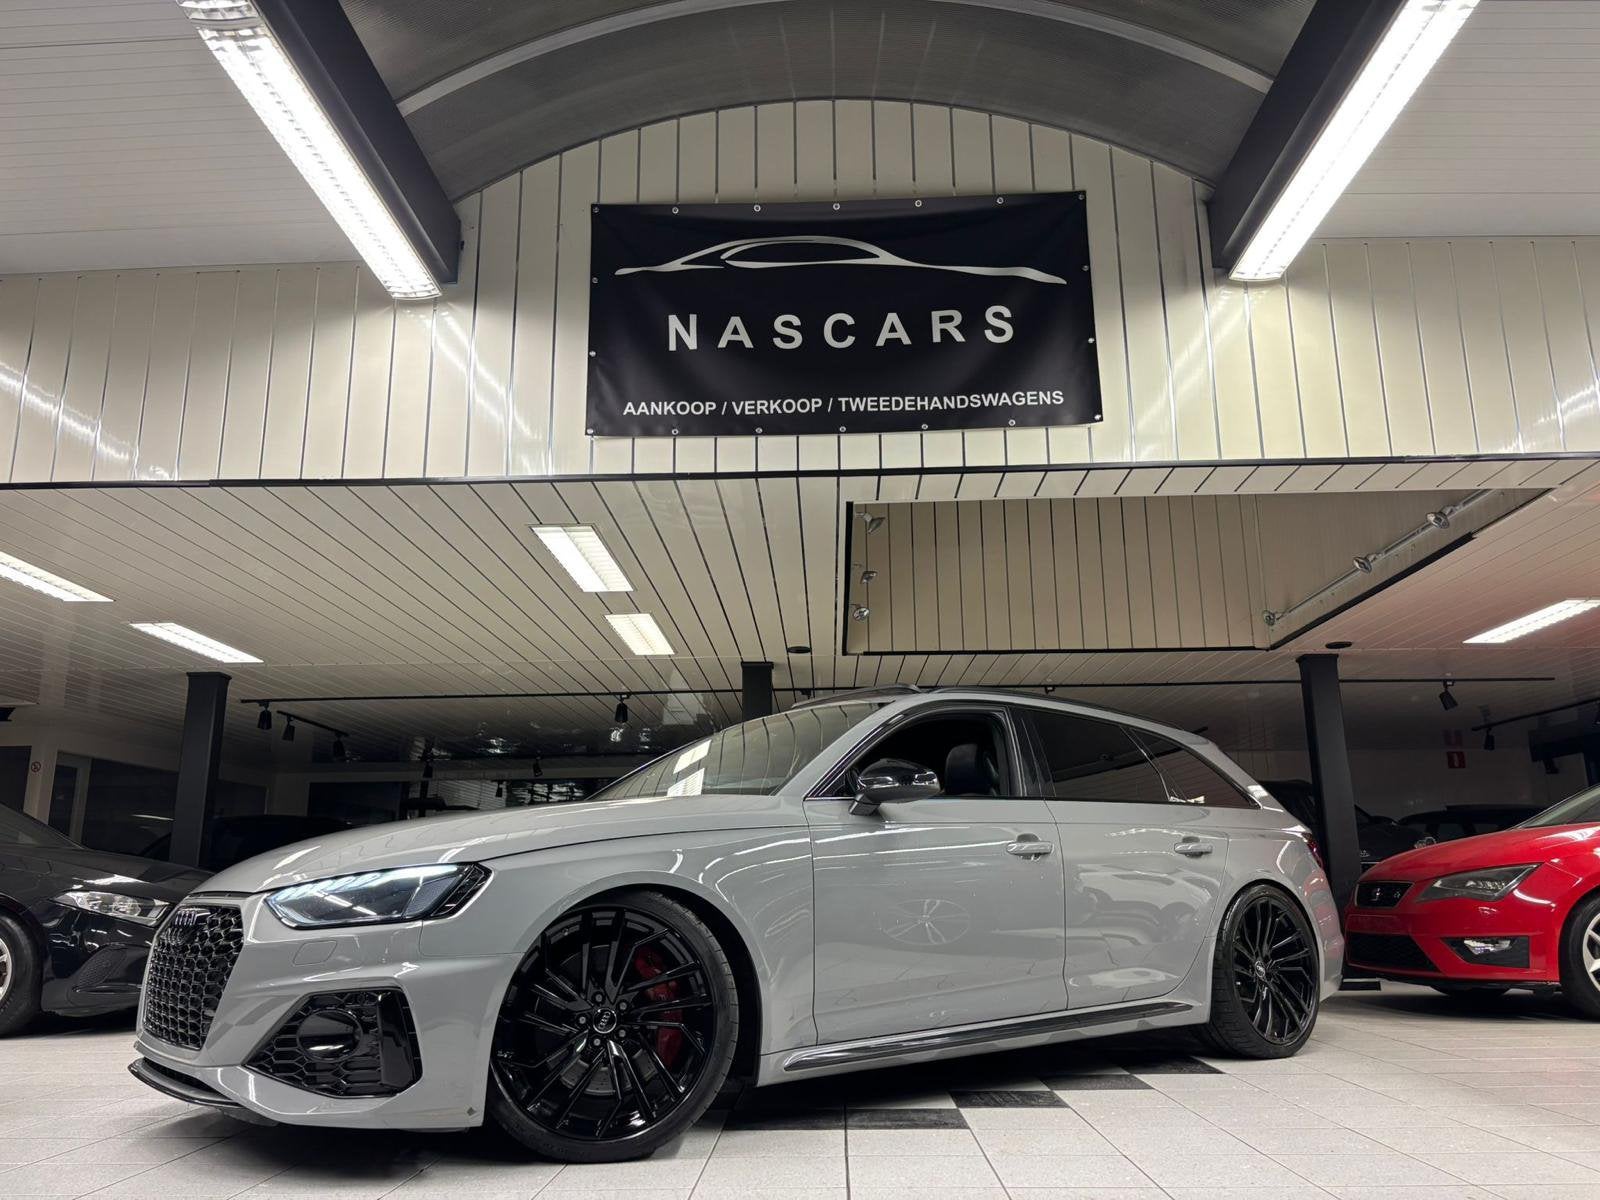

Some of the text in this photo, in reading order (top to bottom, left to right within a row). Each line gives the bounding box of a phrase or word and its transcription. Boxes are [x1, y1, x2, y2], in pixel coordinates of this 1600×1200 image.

[667, 305, 1015, 352] NASCARS
[622, 400, 717, 416] AANKOOP
[731, 397, 823, 415] VERKOOP
[837, 390, 1065, 412] TWEEDEHANDSWAGENS
